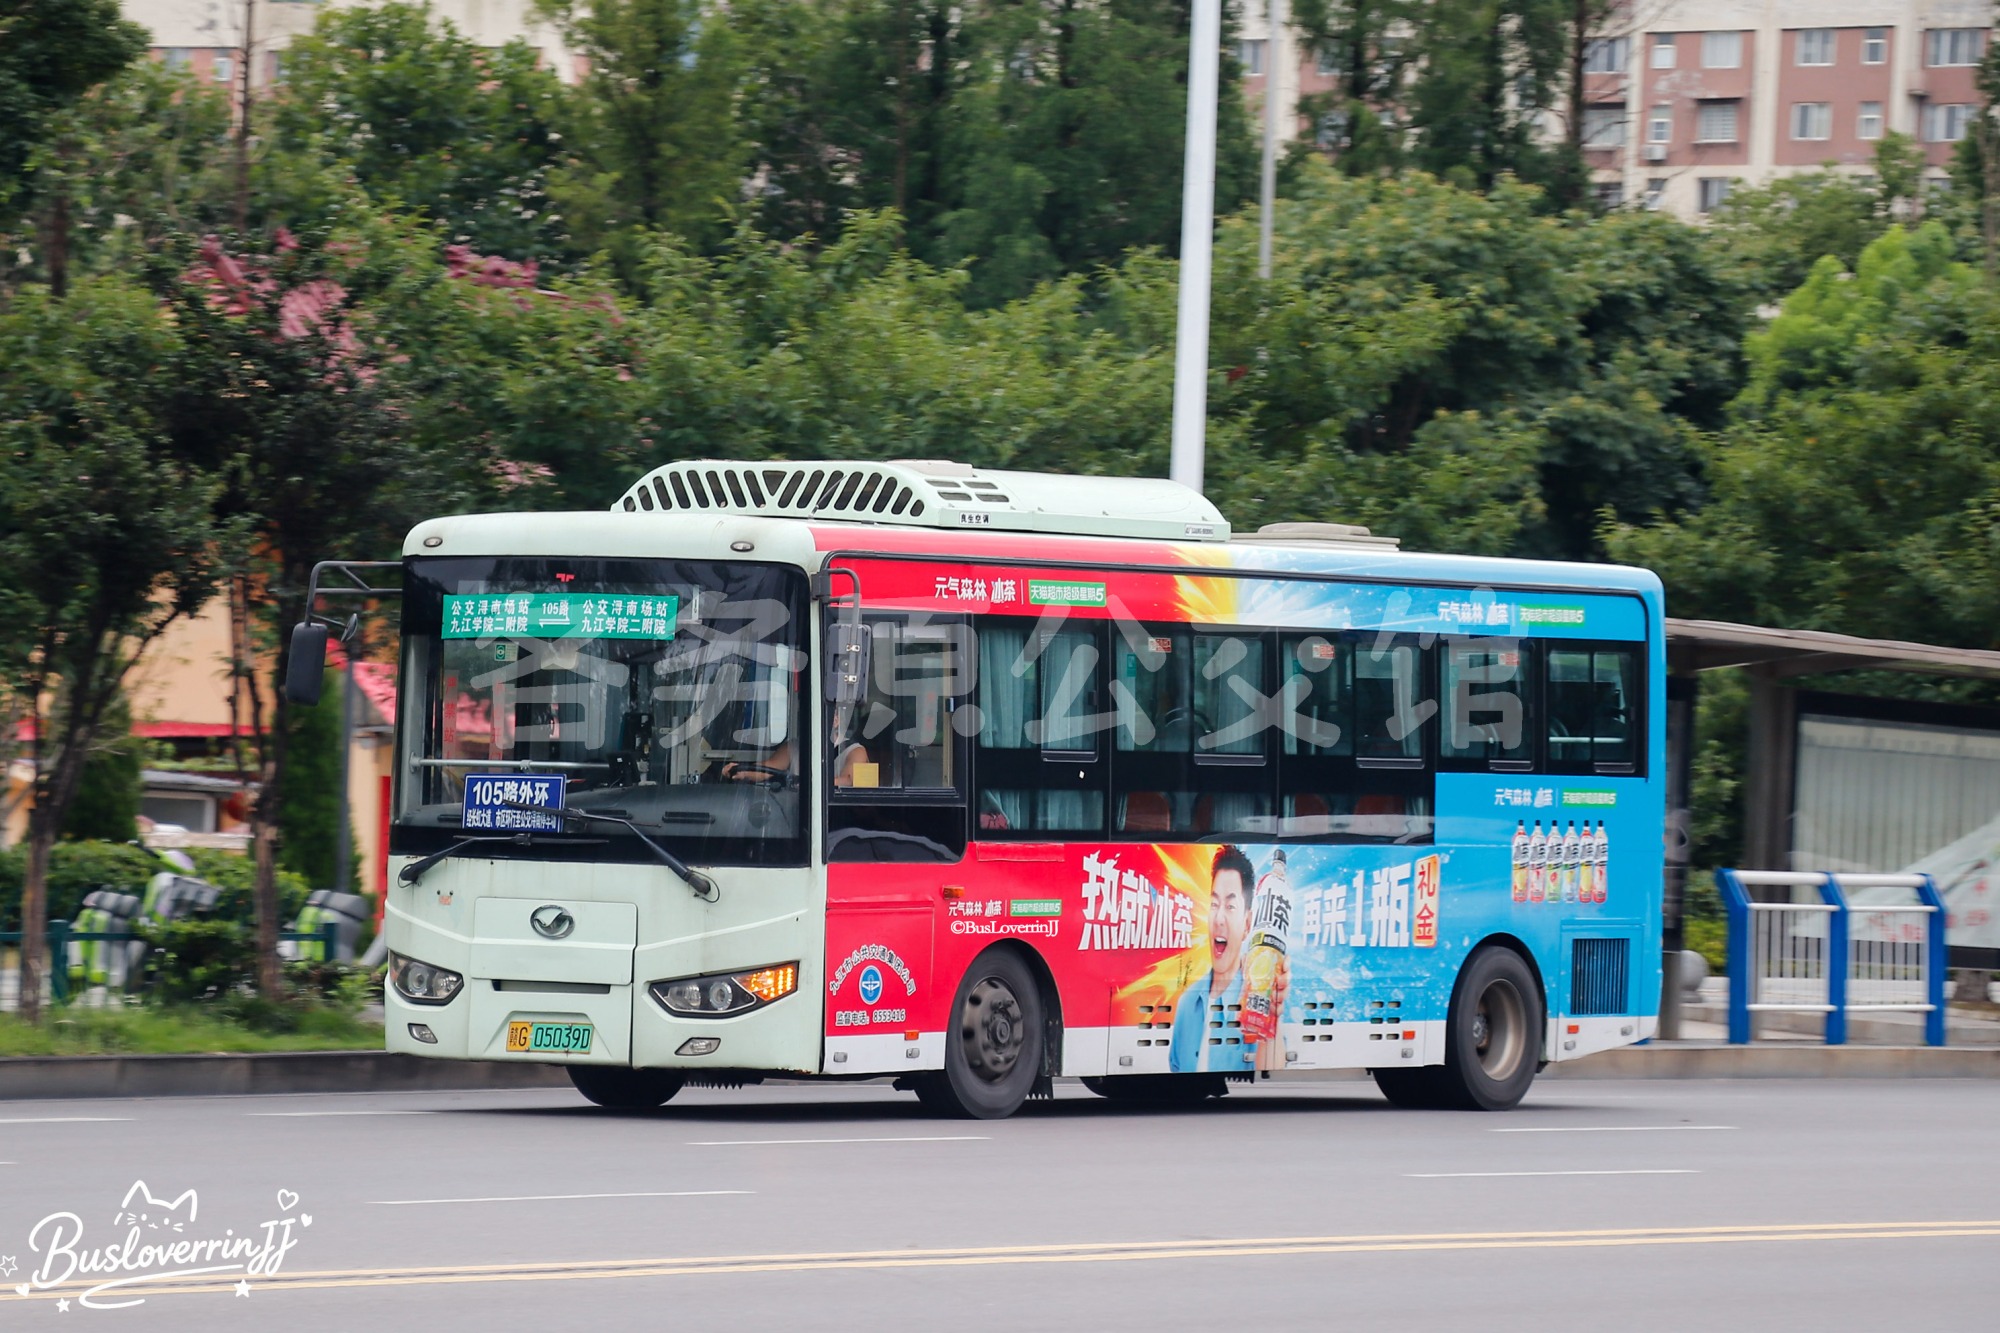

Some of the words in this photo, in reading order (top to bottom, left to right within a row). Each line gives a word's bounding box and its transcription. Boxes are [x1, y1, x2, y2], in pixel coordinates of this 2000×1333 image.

[934, 576, 987, 602] 元气森林
[991, 577, 1016, 604] 冰茶
[1030, 585, 1105, 602] 天猫超市超级星期5
[451, 600, 529, 616] 公交浔南场站
[542, 602, 570, 616] 105路
[582, 599, 669, 616] 公交浔南场站
[1437, 601, 1484, 623] 元气森林
[450, 616, 529, 633] 九江学院二附院
[581, 617, 667, 635] 九江学院二附院
[472, 781, 550, 806] 105路外环
[948, 901, 983, 917] 元气森林
[1078, 850, 1194, 950] 热就冰茶
[1302, 862, 1412, 948] 再来1瓶
[1416, 862, 1437, 940] 礼金
[829, 944, 917, 996] 九江市公共交通集团公司
